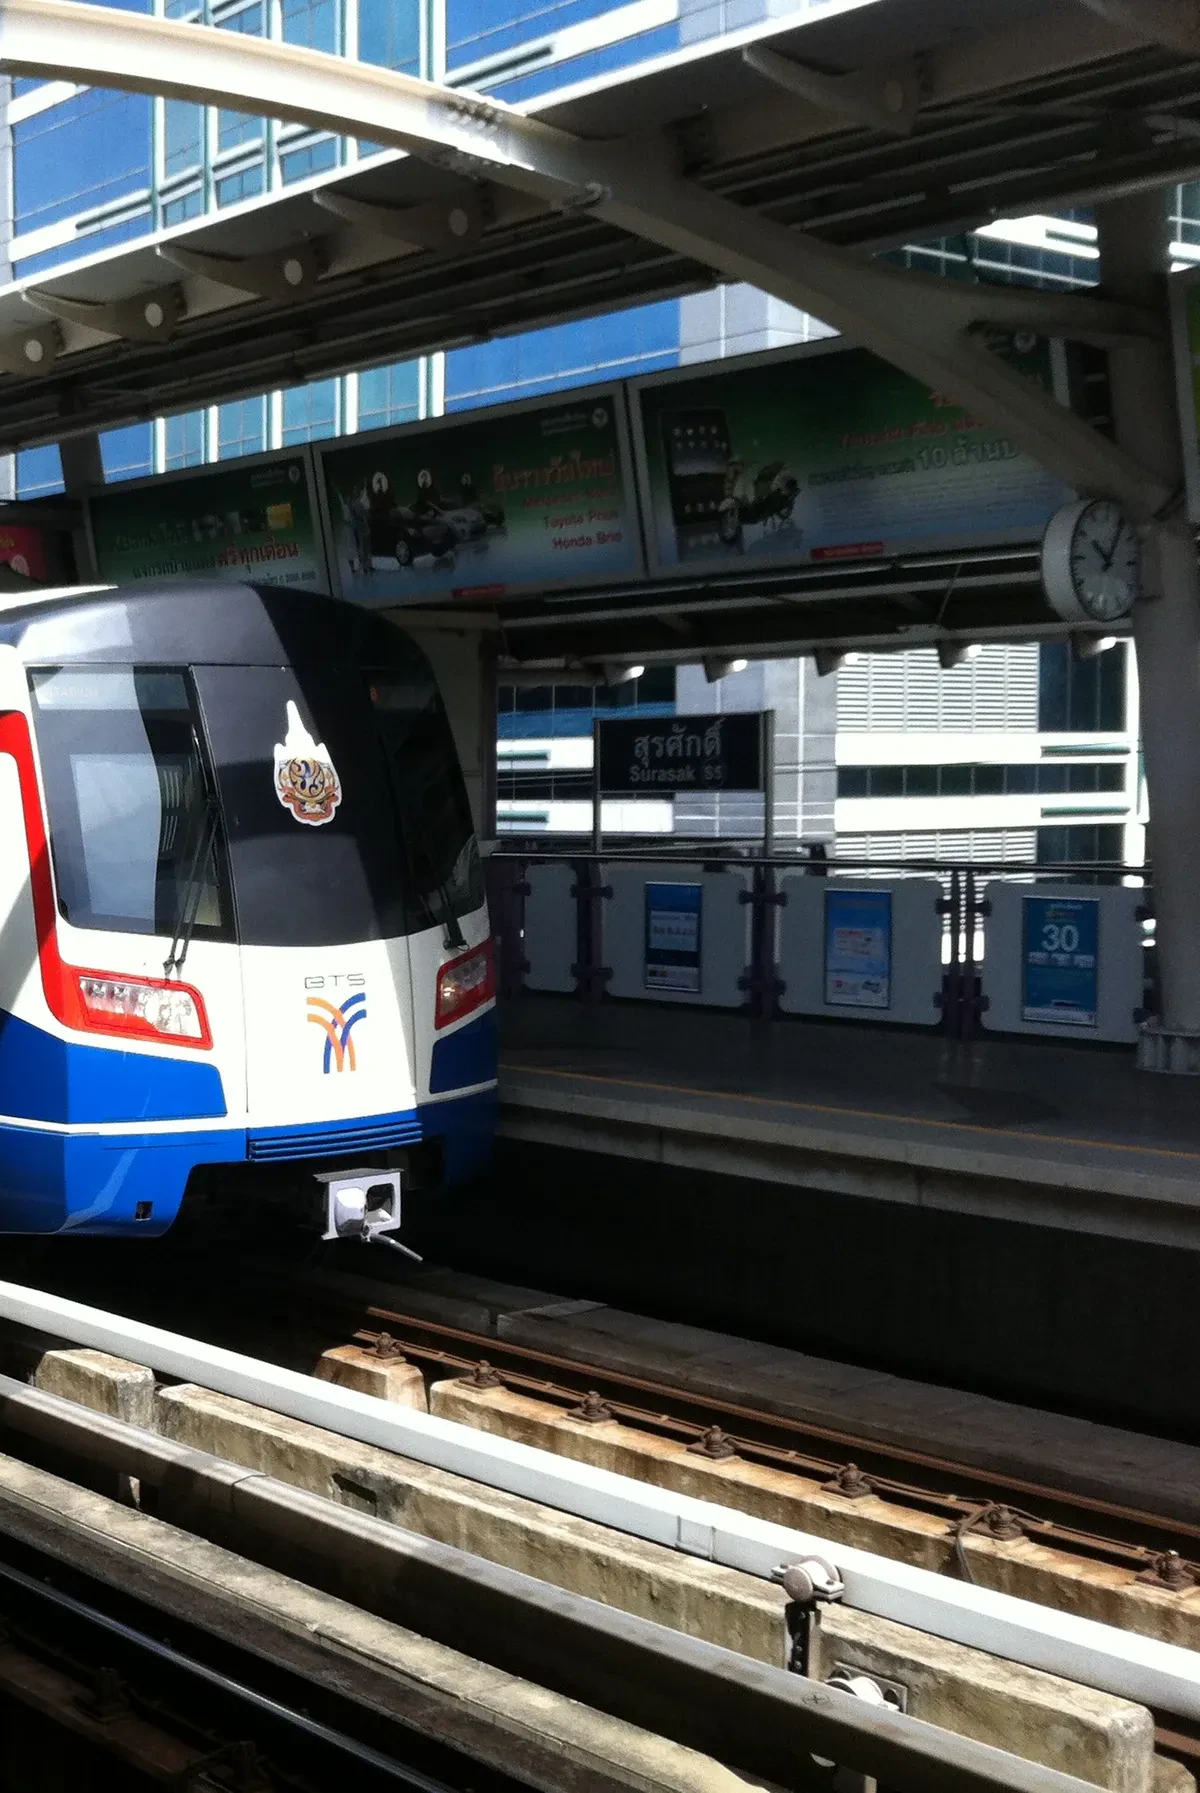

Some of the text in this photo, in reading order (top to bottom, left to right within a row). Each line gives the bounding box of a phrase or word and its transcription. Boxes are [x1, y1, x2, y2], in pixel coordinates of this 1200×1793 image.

[916, 445, 948, 469] 10
[551, 536, 593, 550] Honda
[633, 717, 726, 768] สุรศักดิ์
[629, 764, 724, 783] Surasak S5
[1041, 924, 1080, 953] 30
[304, 973, 367, 990] BTS
